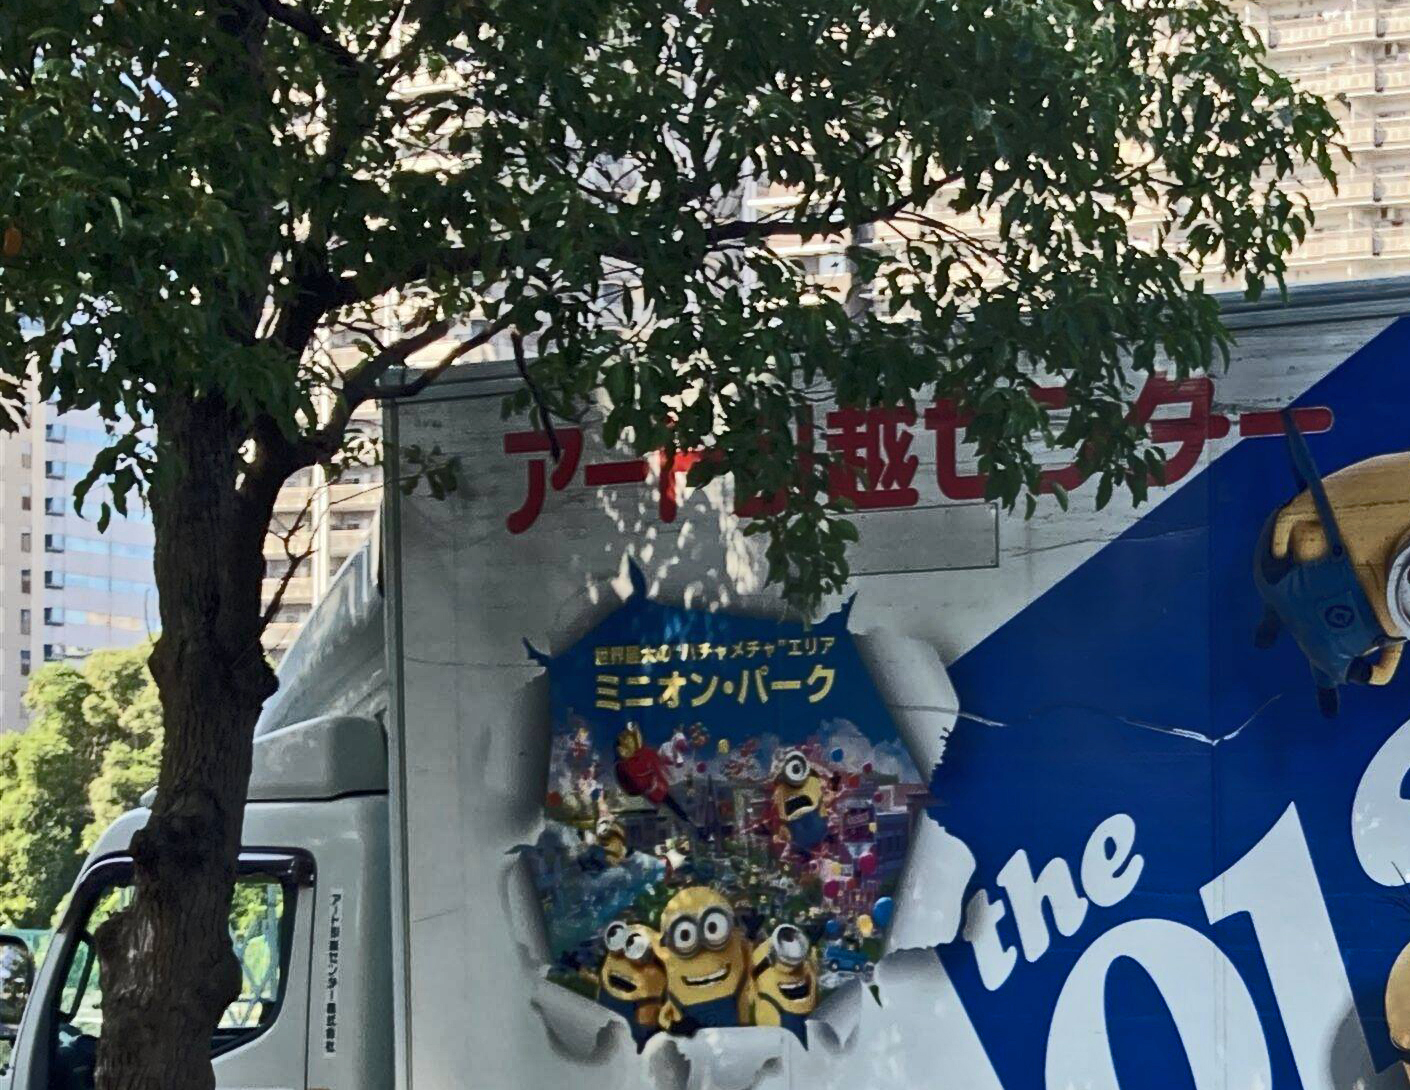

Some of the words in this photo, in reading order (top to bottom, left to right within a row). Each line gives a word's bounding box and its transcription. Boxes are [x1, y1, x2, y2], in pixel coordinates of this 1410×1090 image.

[595, 664, 836, 711] ミニオン・パーク
[963, 813, 1145, 992] the
